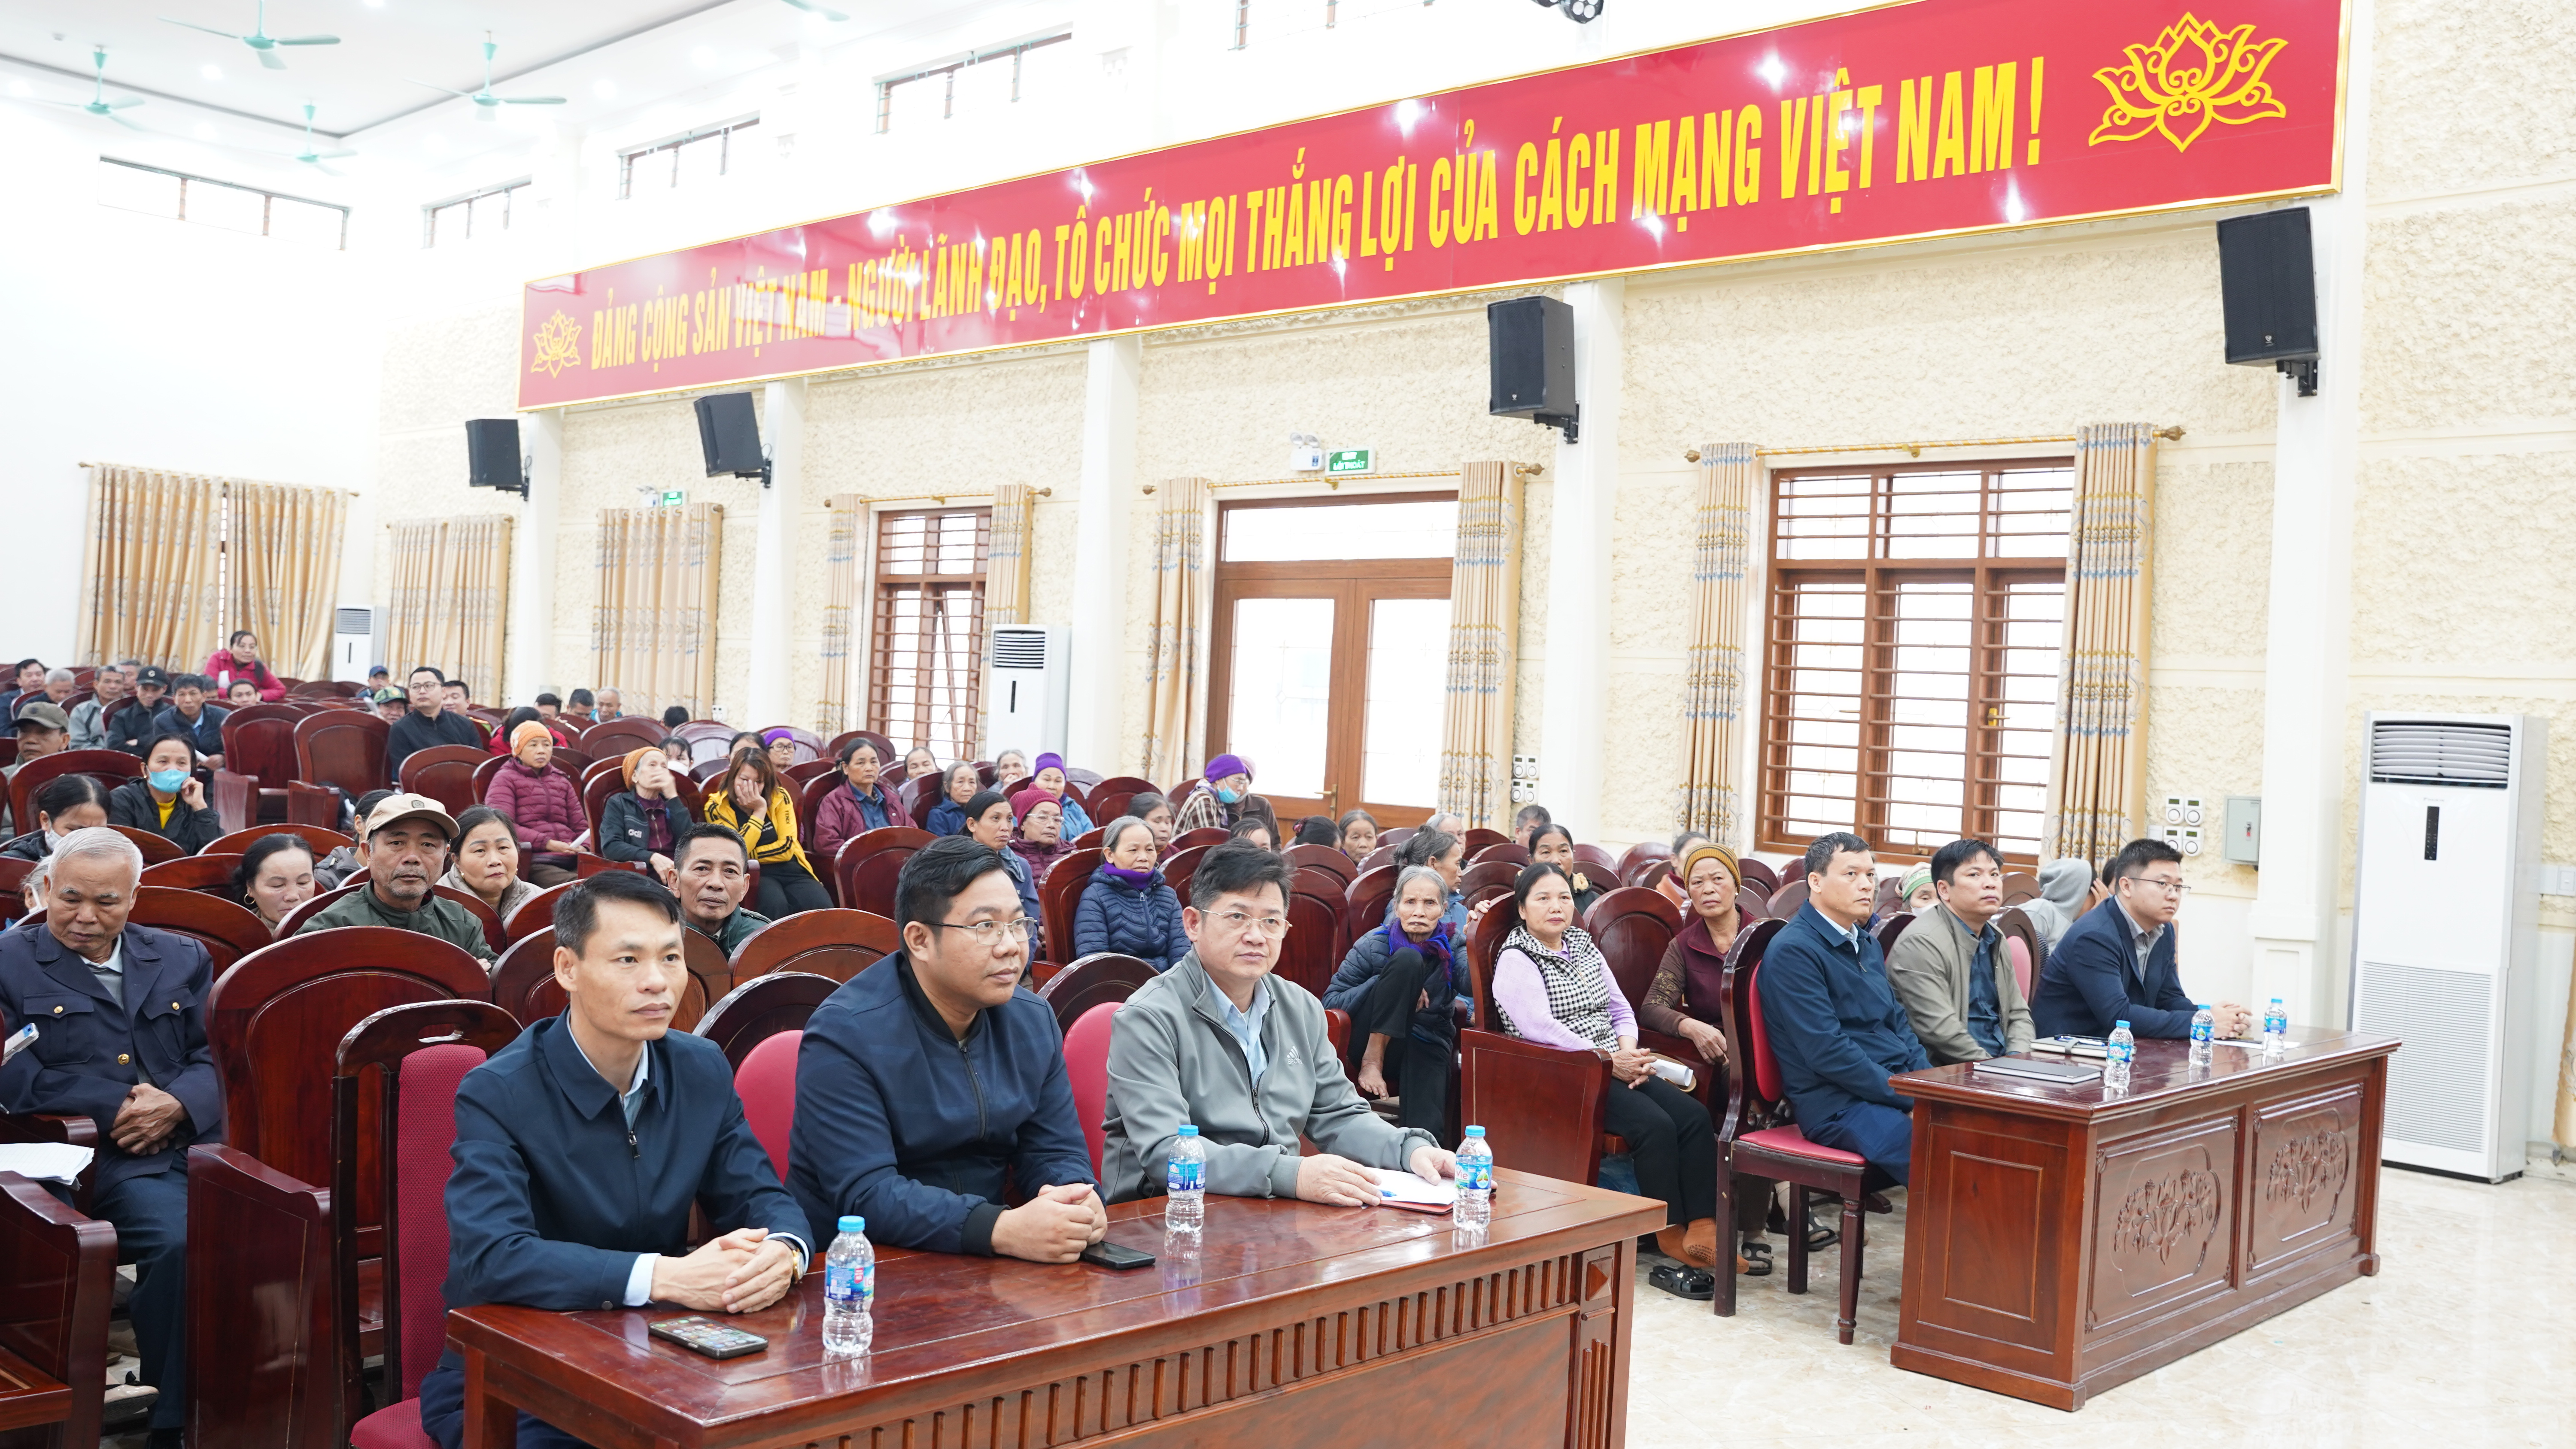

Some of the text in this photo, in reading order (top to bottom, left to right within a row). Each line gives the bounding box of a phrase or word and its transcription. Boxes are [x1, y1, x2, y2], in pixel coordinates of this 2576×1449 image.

[591, 288, 638, 370] ĐẢNG
[641, 284, 689, 373] CỘNG
[693, 267, 731, 355] SẢN
[735, 265, 778, 358] VIỆT
[780, 268, 828, 342] NAM
[846, 234, 916, 332] NGƯỜI
[920, 233, 983, 321] LÃNH
[988, 228, 1047, 322] ĐẠO,
[1094, 187, 1170, 295] CHỨC
[1177, 194, 1237, 295] MỌI
[1246, 147, 1353, 273] THẮNG
[1360, 155, 1417, 271] LỢI
[1428, 119, 1498, 248] CỦA
[1514, 116, 1620, 236] CÁCH
[1631, 104, 1762, 233] MẠNG
[1781, 67, 1882, 214] VIỆT
